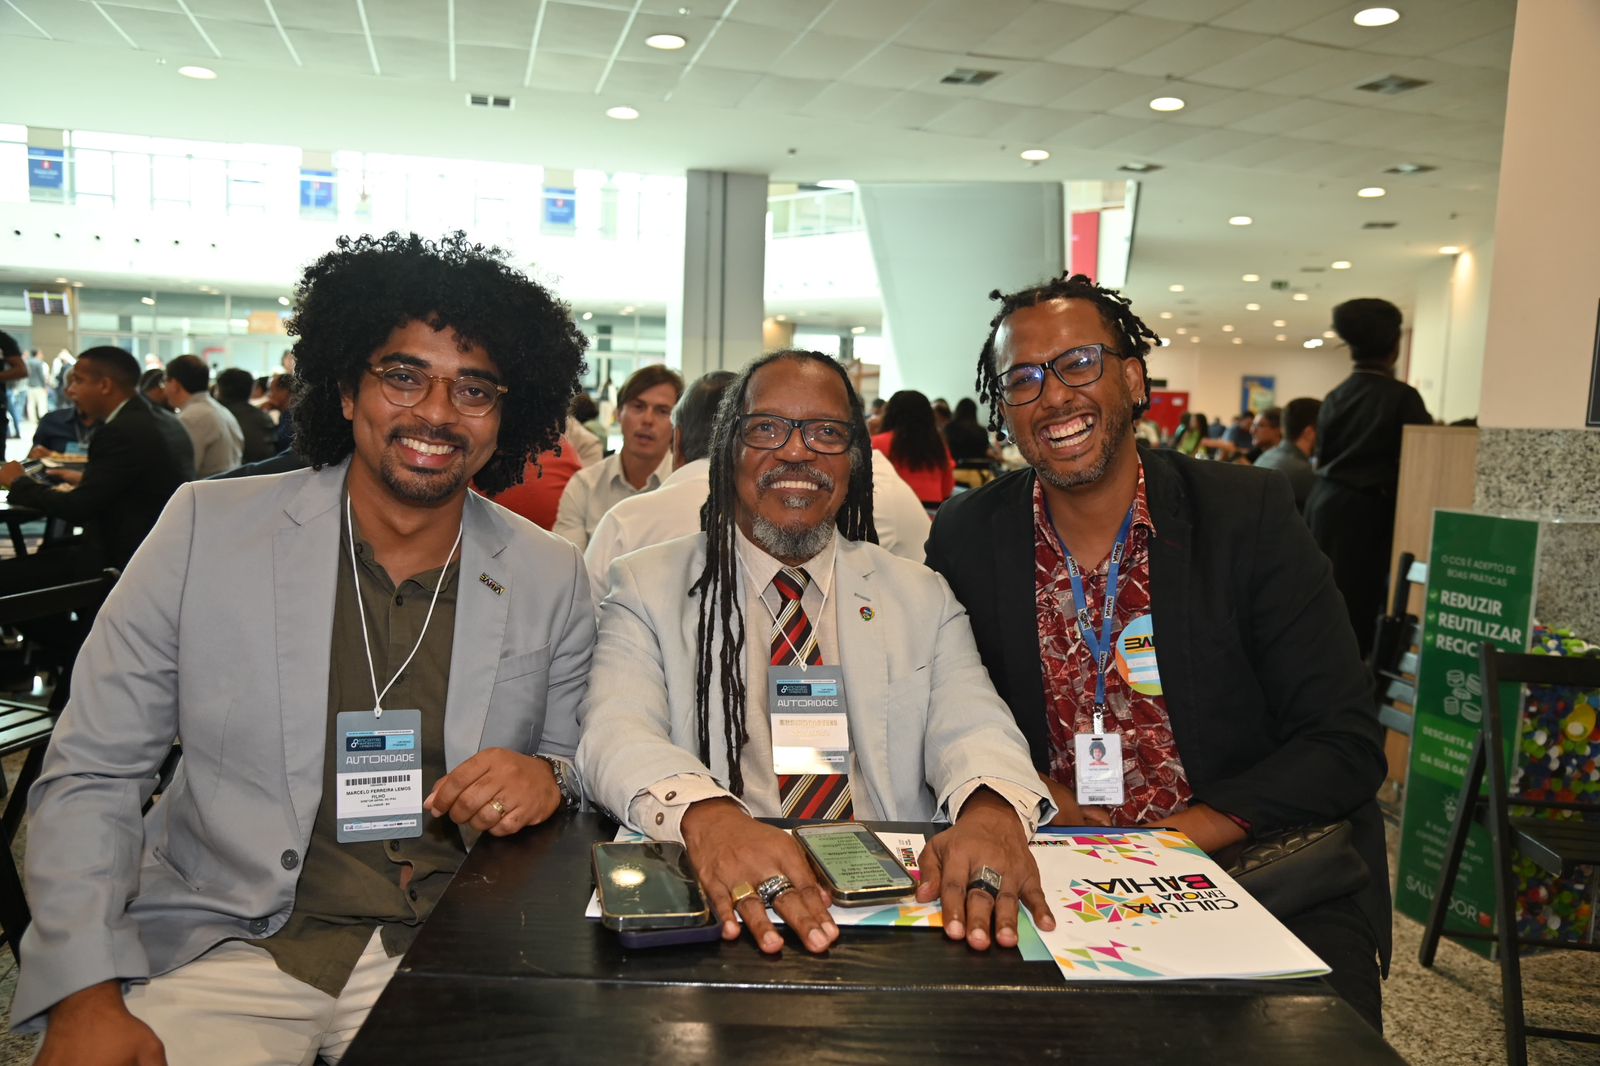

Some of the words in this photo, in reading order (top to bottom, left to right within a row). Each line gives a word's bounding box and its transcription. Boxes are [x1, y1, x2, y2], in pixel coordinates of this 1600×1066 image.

[1473, 560, 1504, 573] ADEPTO
[1505, 565, 1516, 575] DE
[1447, 568, 1468, 580] BOAS
[1469, 571, 1508, 587] PRÁTICAS
[1440, 589, 1503, 616] REDUZIR
[1438, 611, 1522, 645] REUTILIZAR
[777, 699, 839, 707] AUTORIDADE
[1422, 726, 1466, 748] DESCARTE
[345, 753, 415, 765] AUTORIDADE
[1082, 873, 1218, 894] BAHIA
[1156, 891, 1205, 901] TODA
[1203, 890, 1226, 899] EM
[1405, 874, 1478, 923] SALVDOR
[1123, 898, 1239, 914] CULTURA
